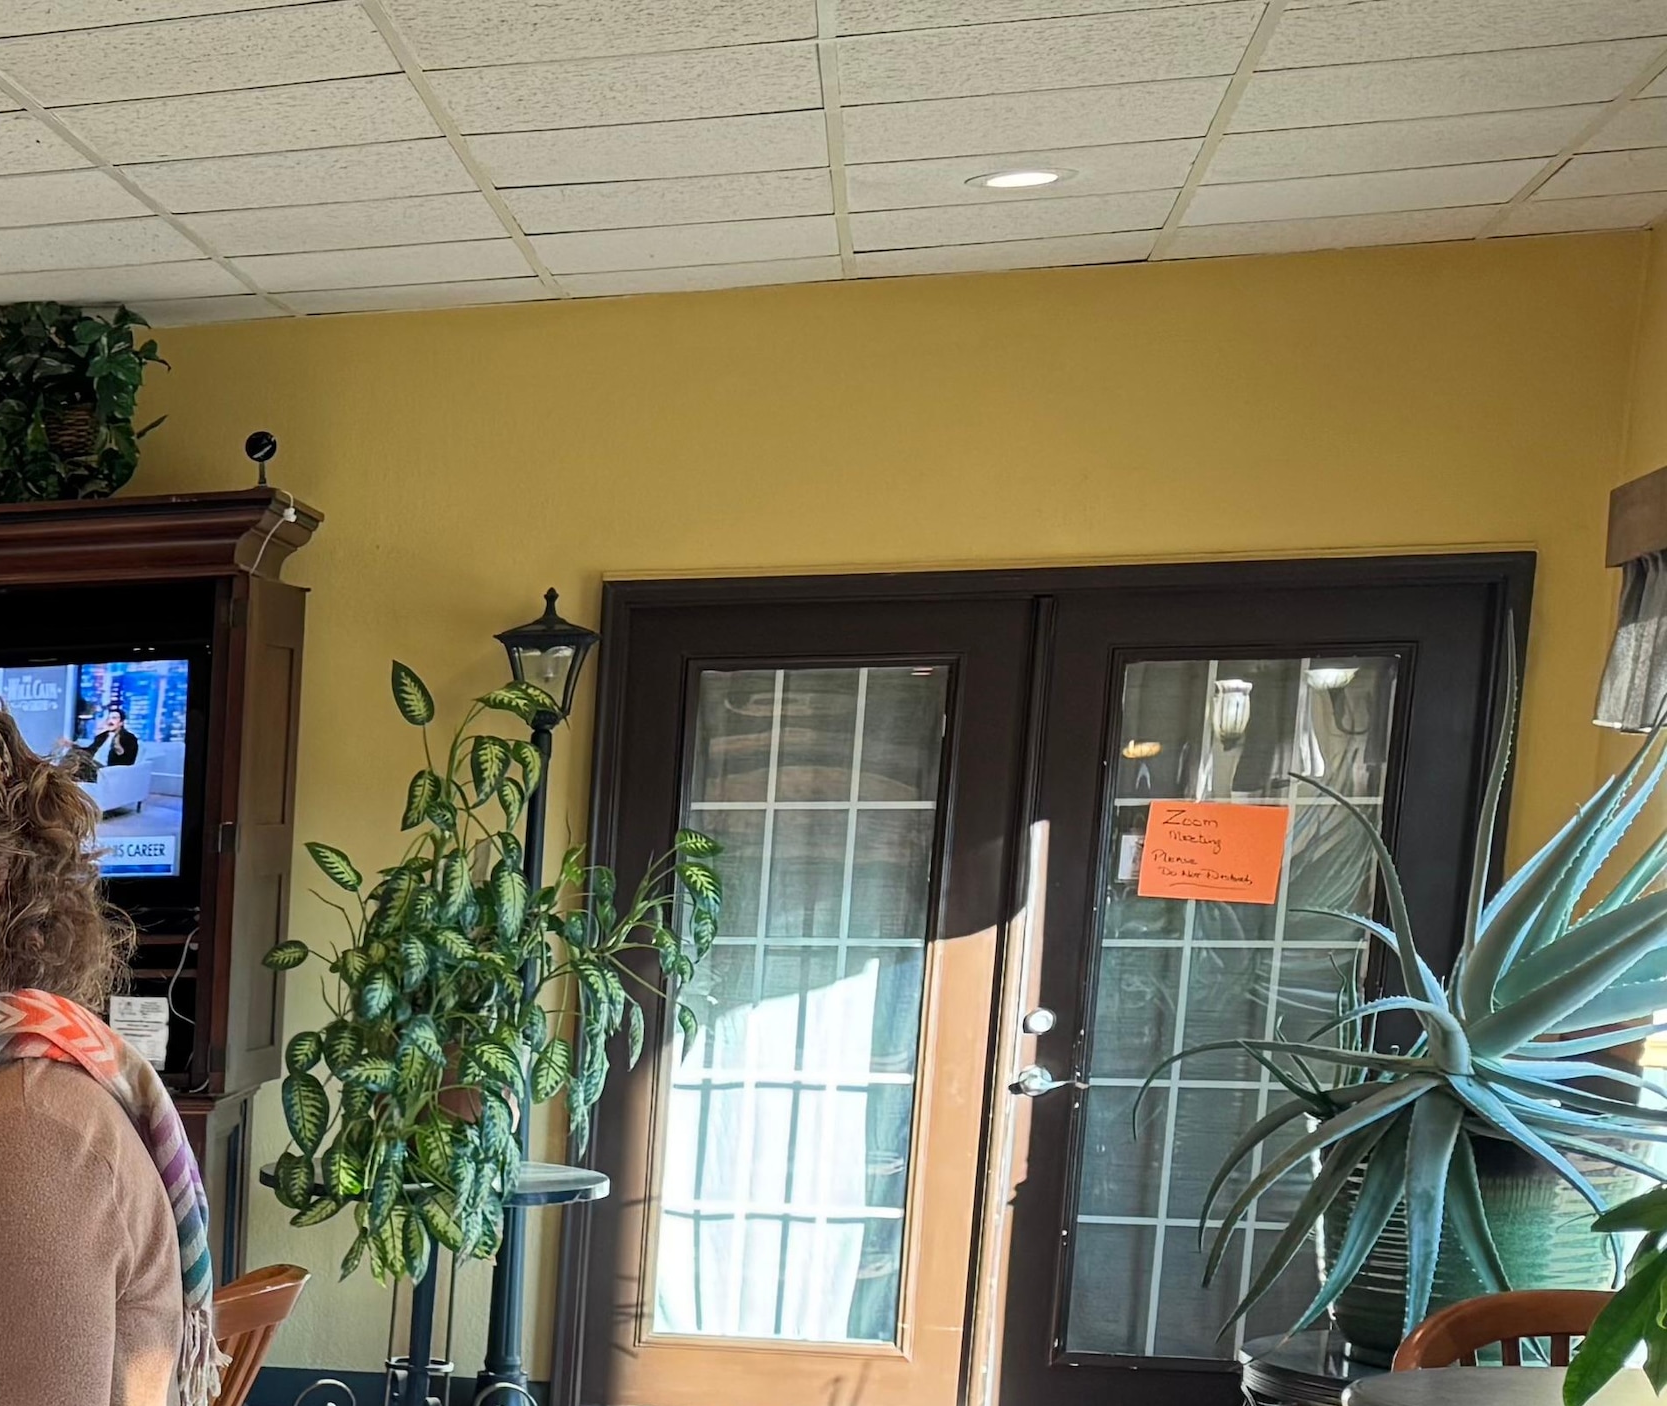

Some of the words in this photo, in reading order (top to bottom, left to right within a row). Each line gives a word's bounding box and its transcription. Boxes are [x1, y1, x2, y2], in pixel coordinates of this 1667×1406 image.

[1162, 809, 1219, 828] Zoom
[127, 843, 166, 857] CAREER
[1169, 830, 1222, 855] Meeting
